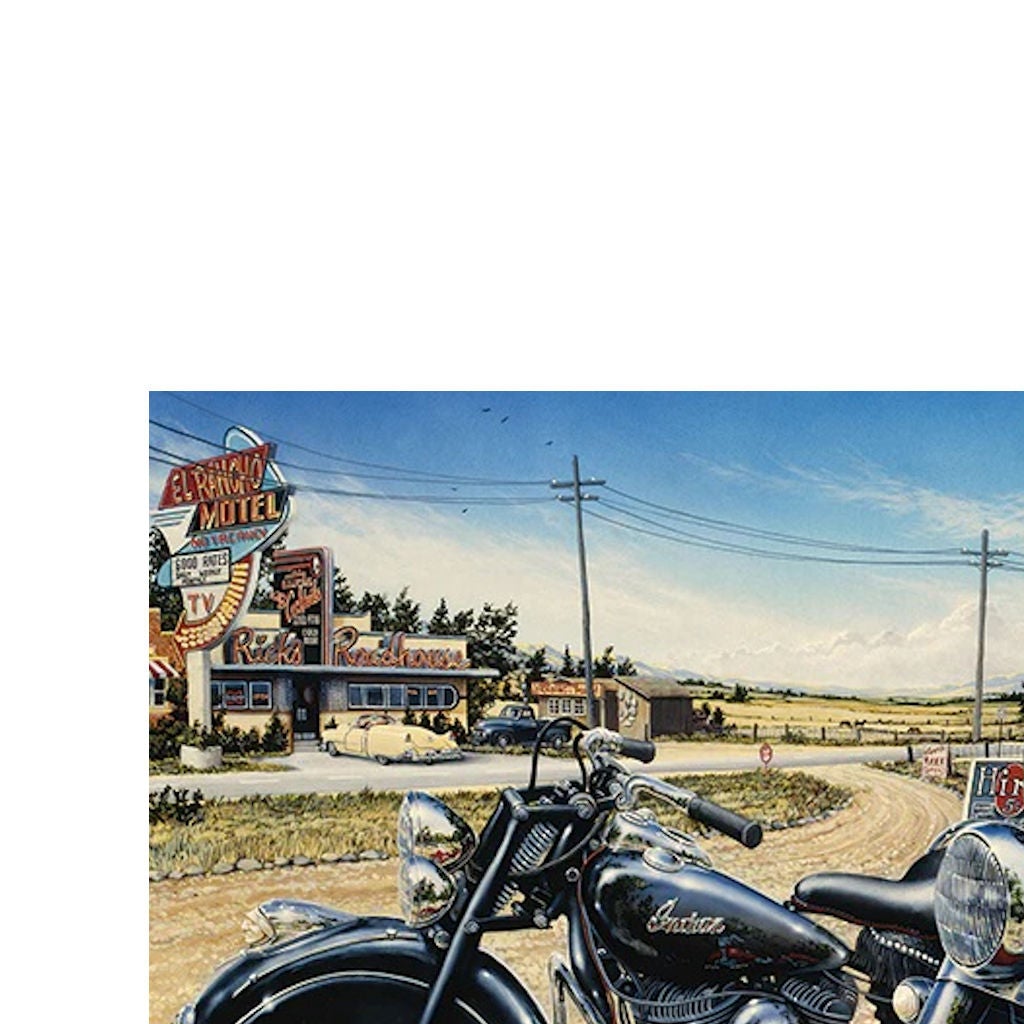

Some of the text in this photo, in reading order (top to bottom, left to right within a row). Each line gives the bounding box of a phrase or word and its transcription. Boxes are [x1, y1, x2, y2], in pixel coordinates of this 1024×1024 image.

[199, 492, 281, 531] MOTEL
[187, 592, 215, 613] TV
[646, 896, 726, 934] Indian
